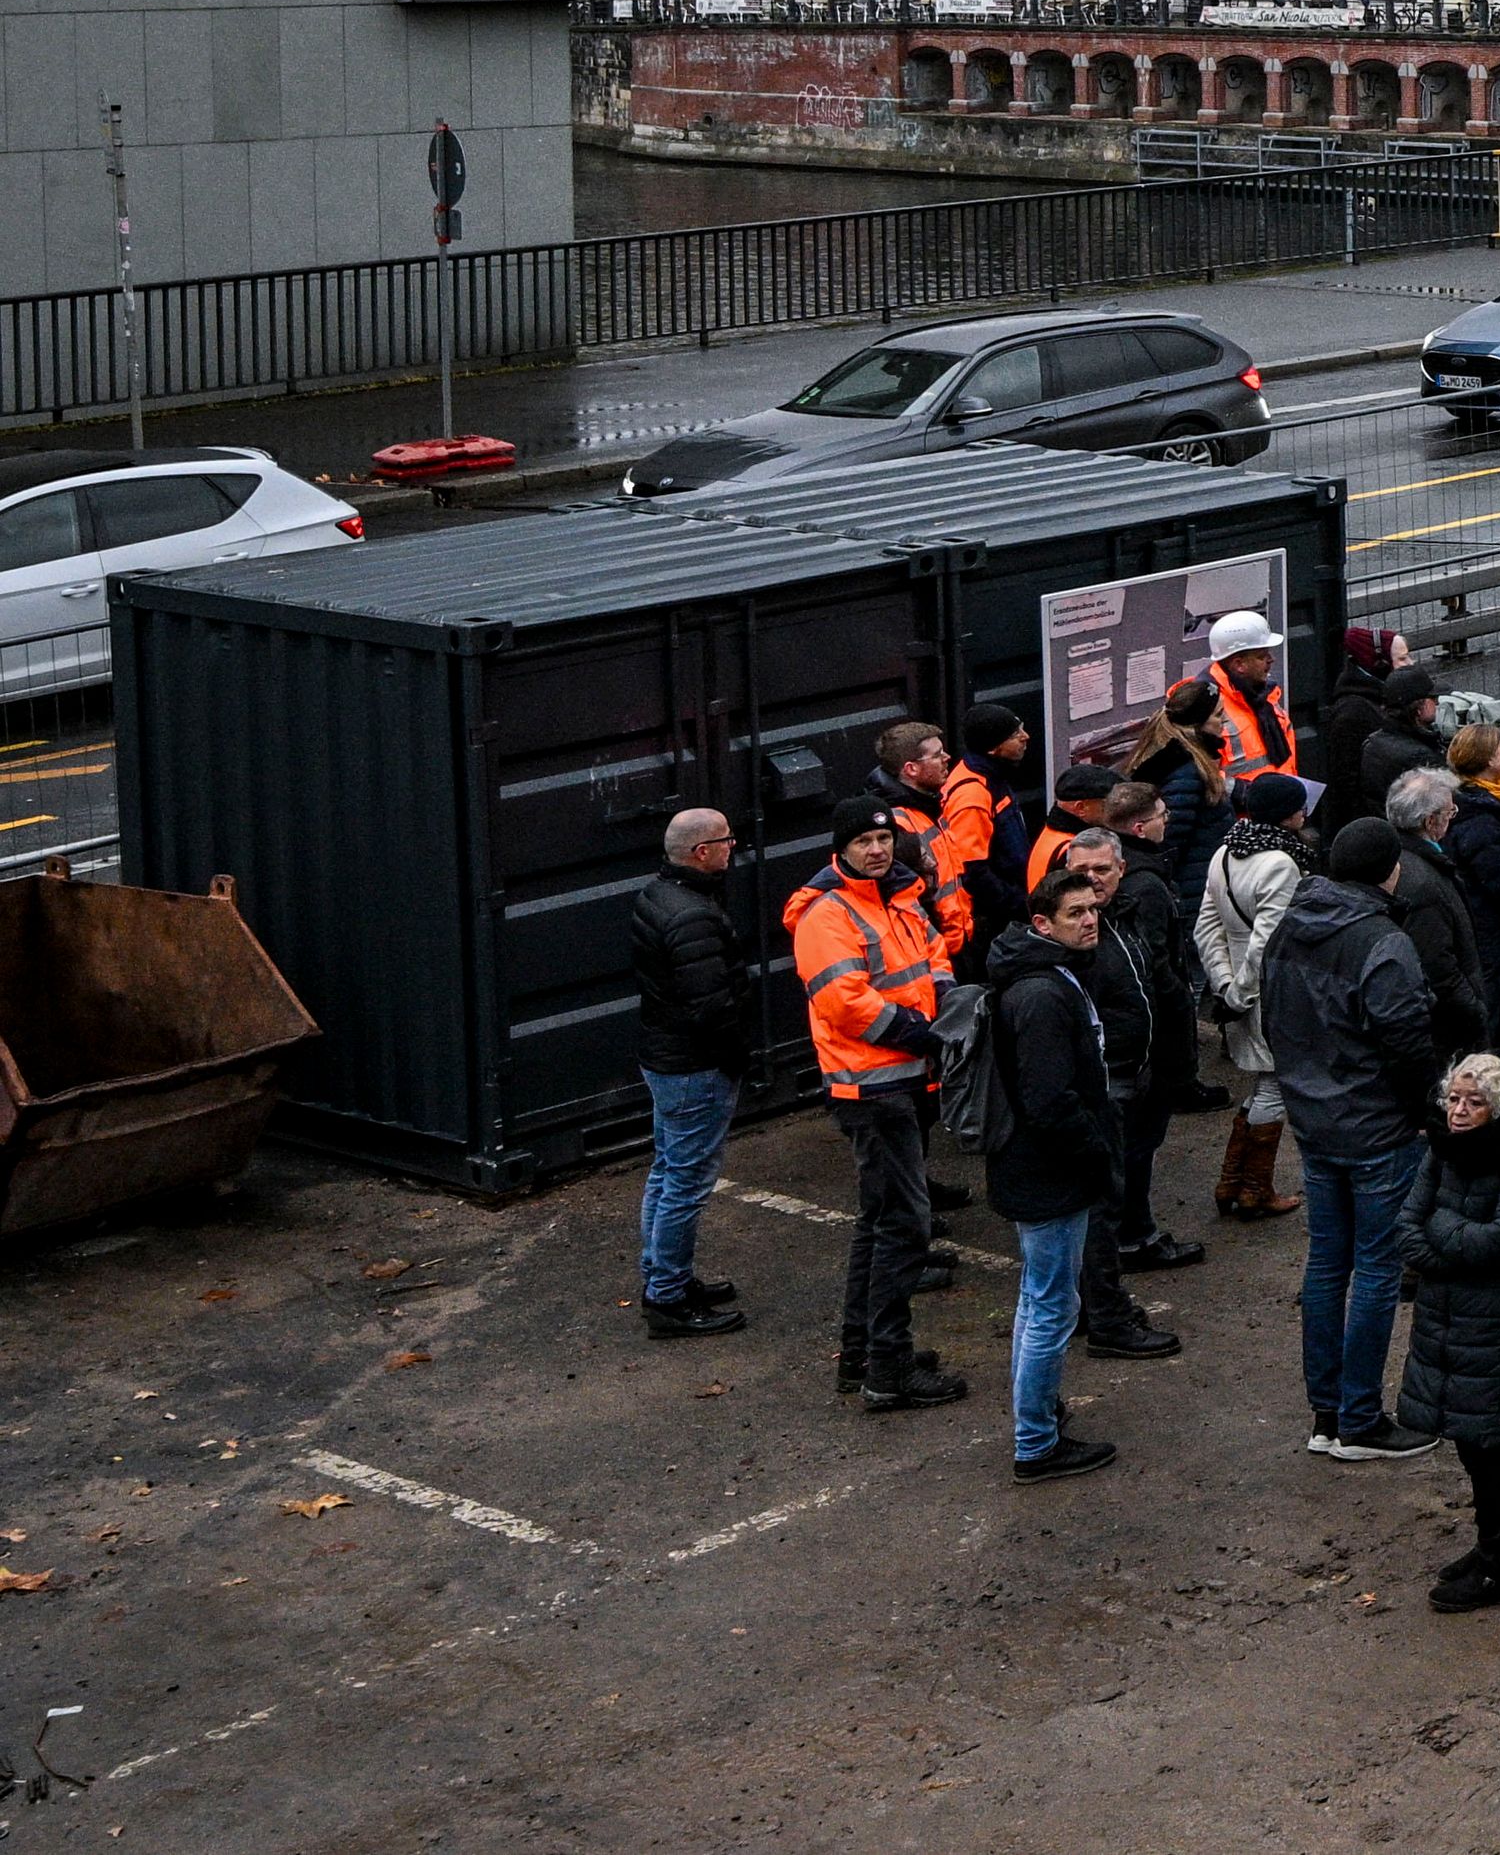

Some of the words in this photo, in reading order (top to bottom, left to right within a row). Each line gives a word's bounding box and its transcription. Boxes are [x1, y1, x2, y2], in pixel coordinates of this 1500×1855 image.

[1257, 10, 1278, 22] San
[1279, 10, 1310, 23] Nicola
[1096, 599, 1108, 608] der
